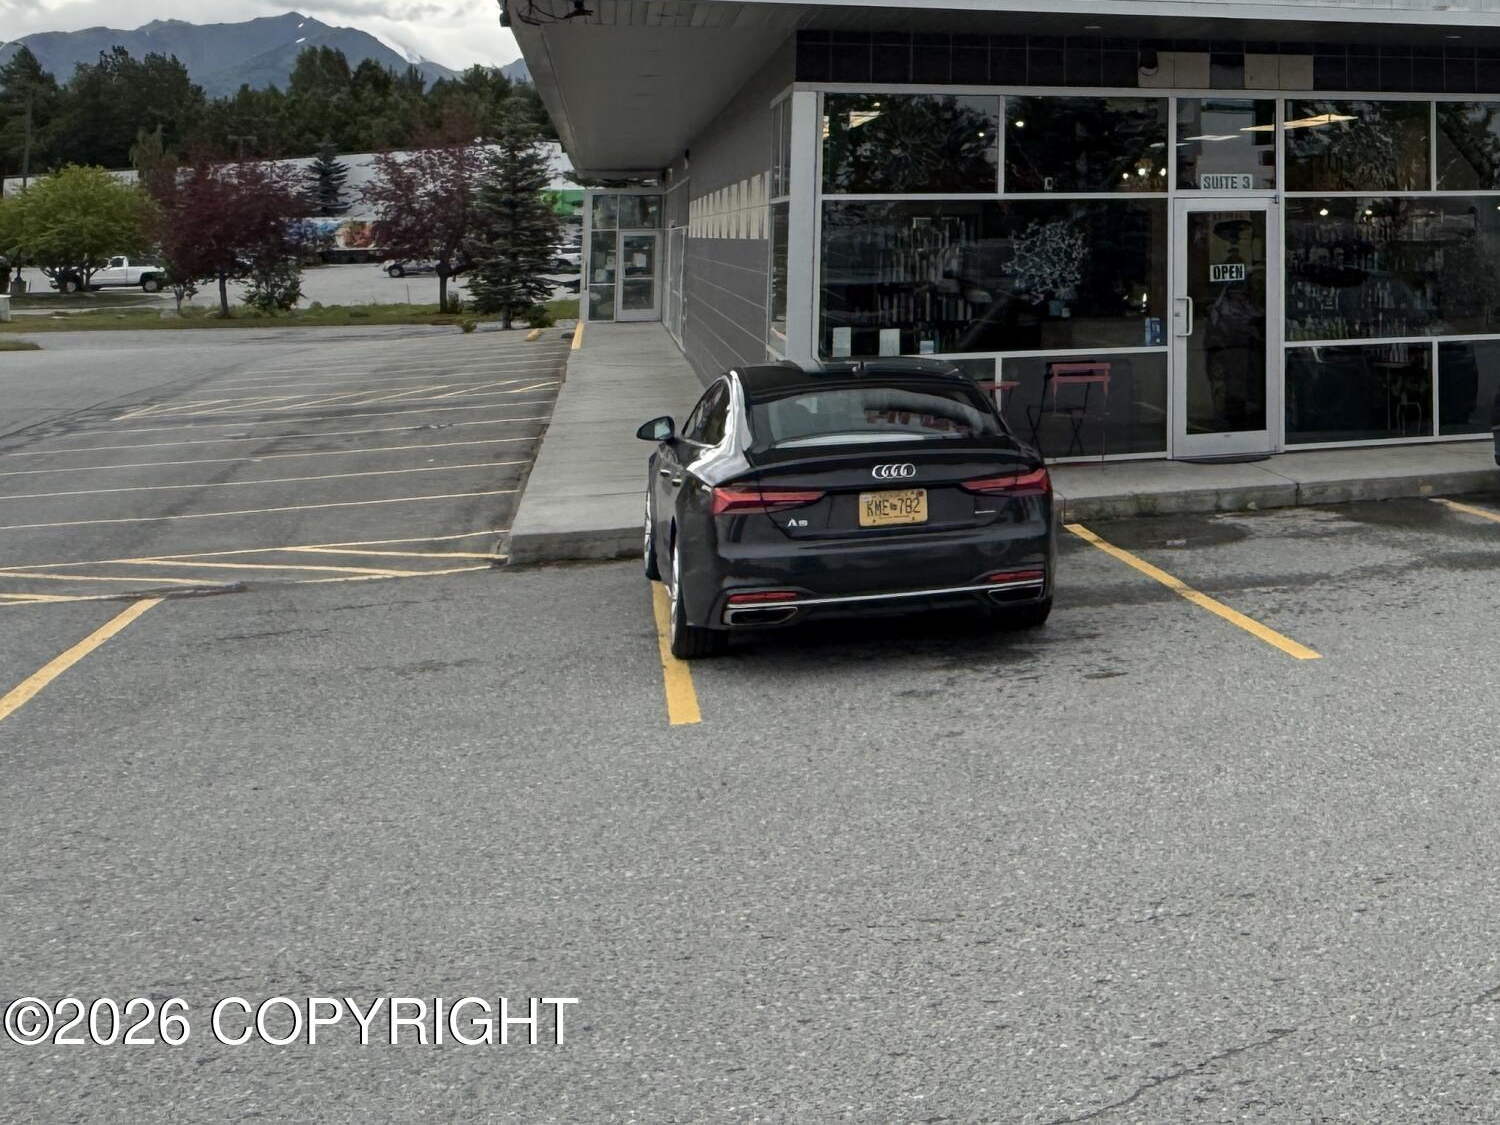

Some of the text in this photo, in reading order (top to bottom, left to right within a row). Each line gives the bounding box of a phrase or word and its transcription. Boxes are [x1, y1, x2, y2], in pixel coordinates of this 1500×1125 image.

[1203, 175, 1251, 190] SUITE 3
[1212, 264, 1244, 280] OPEN
